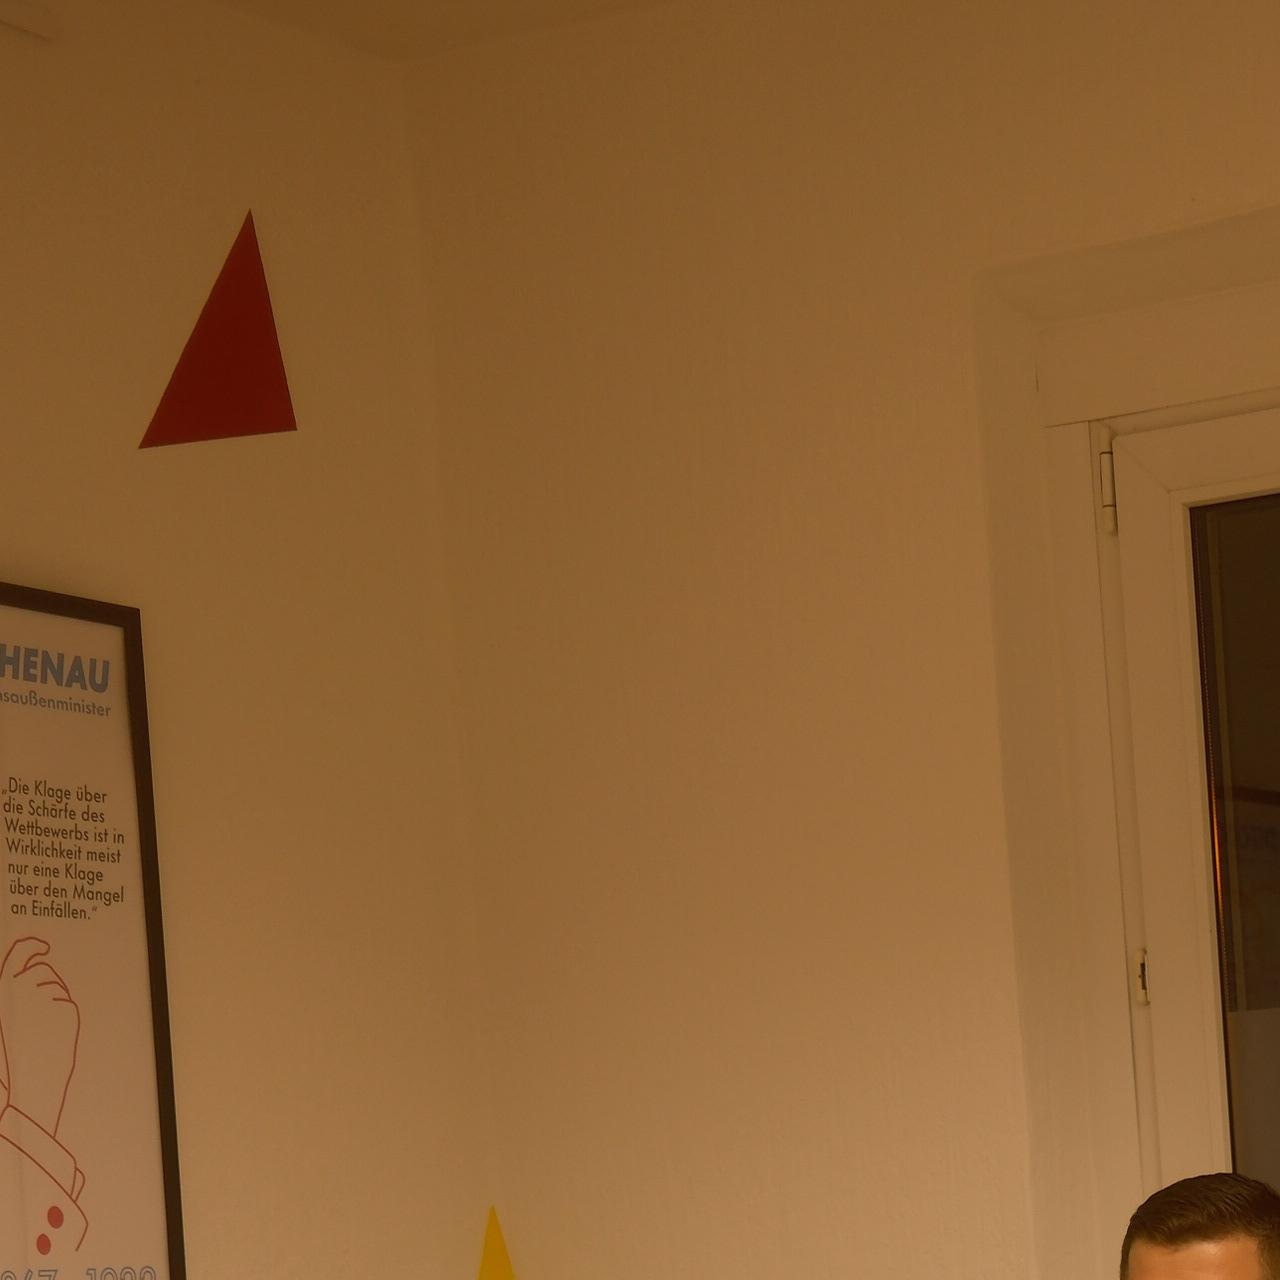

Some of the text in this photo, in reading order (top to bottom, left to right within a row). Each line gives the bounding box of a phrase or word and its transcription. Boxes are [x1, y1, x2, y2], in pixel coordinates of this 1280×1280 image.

[0, 643, 110, 694] HENAU
[34, 780, 72, 804] Klage
[76, 784, 108, 804] über
[3, 796, 105, 823] die Schärfe des
[5, 817, 125, 844] Wettbewerbs ist in
[6, 837, 121, 863] Wirklichkeit meist
[8, 861, 104, 886] nur eine Klage
[9, 877, 125, 906] über den Mangel
[11, 903, 27, 916] an
